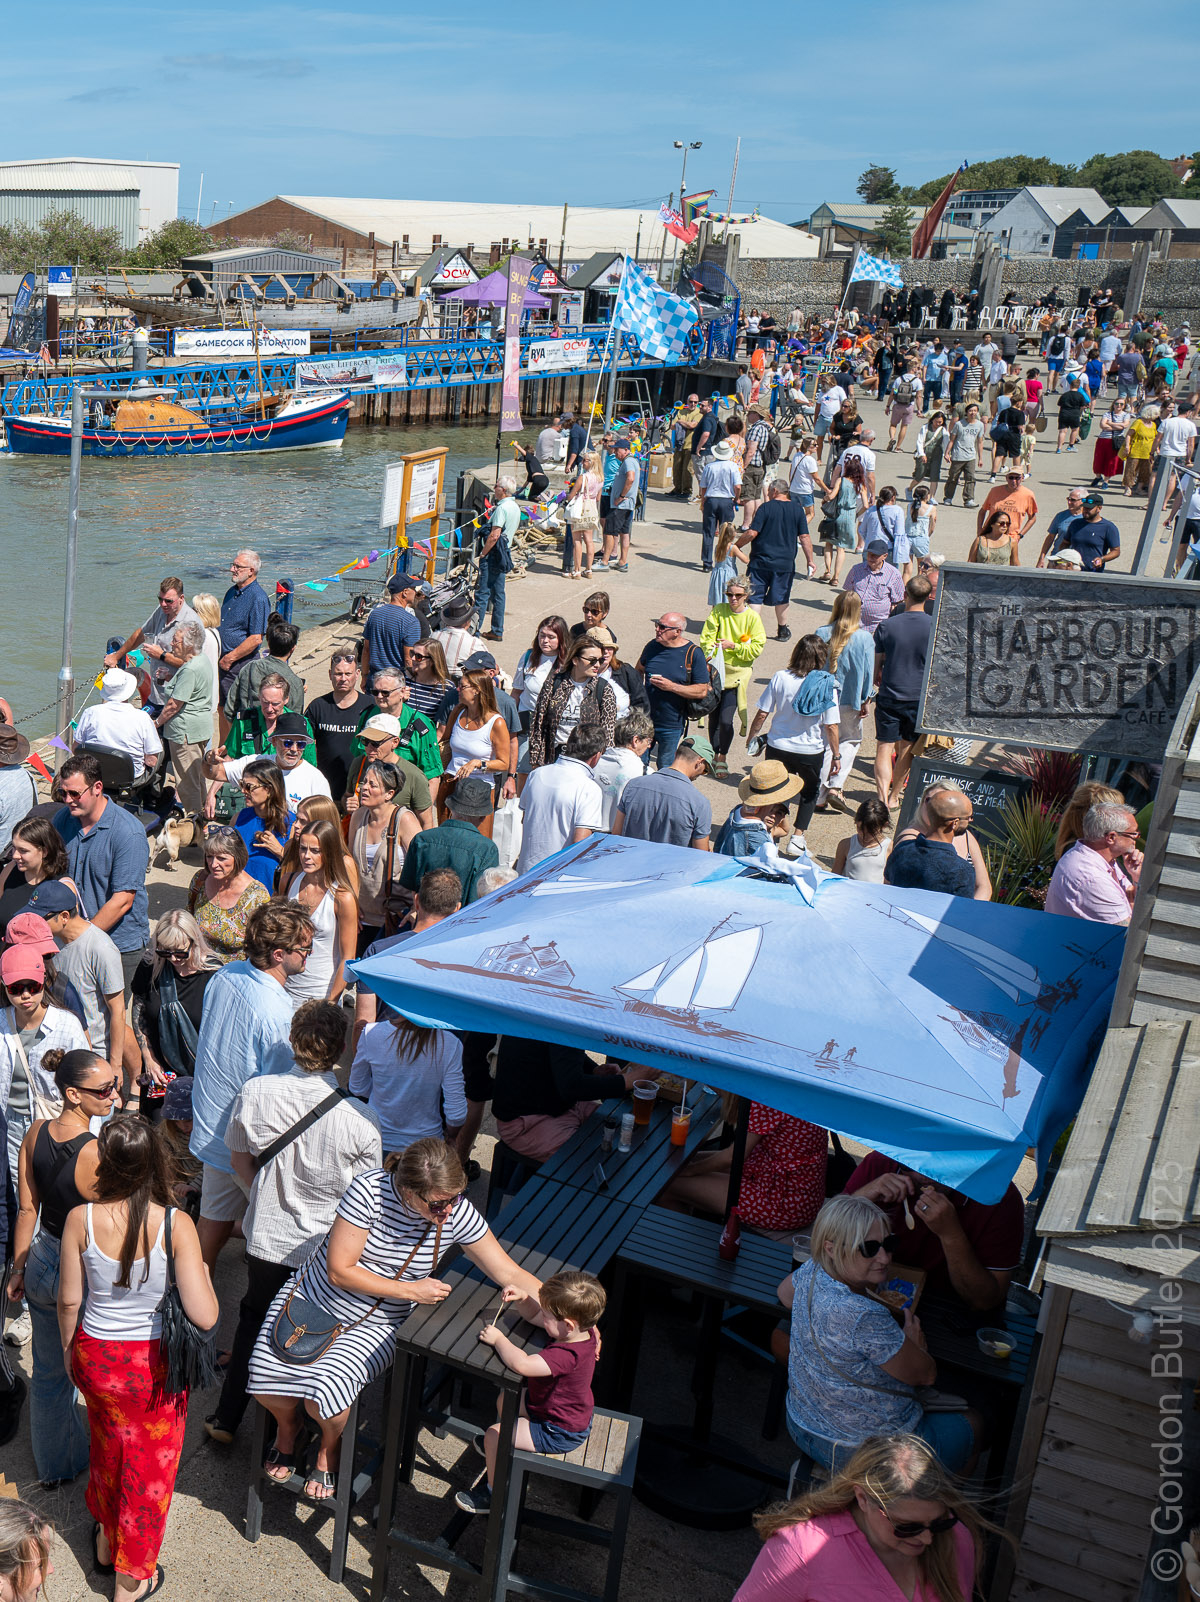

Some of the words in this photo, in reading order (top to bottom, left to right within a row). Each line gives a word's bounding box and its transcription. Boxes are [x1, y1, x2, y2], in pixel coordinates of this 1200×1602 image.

[195, 338, 244, 347] GAMECOCK
[563, 341, 587, 350] OCW
[531, 348, 545, 359] RYA
[301, 363, 334, 371] VINTAGE
[337, 359, 371, 368] LIFEBOAT
[375, 357, 396, 365] TRIPS
[1000, 605, 1021, 616] THE
[979, 616, 1179, 661] HARBOUR
[977, 663, 1178, 709] GARDEN
[1125, 706, 1166, 725] CAFÉ
[976, 784, 995, 796] AND
[1000, 788, 1006, 799] A
